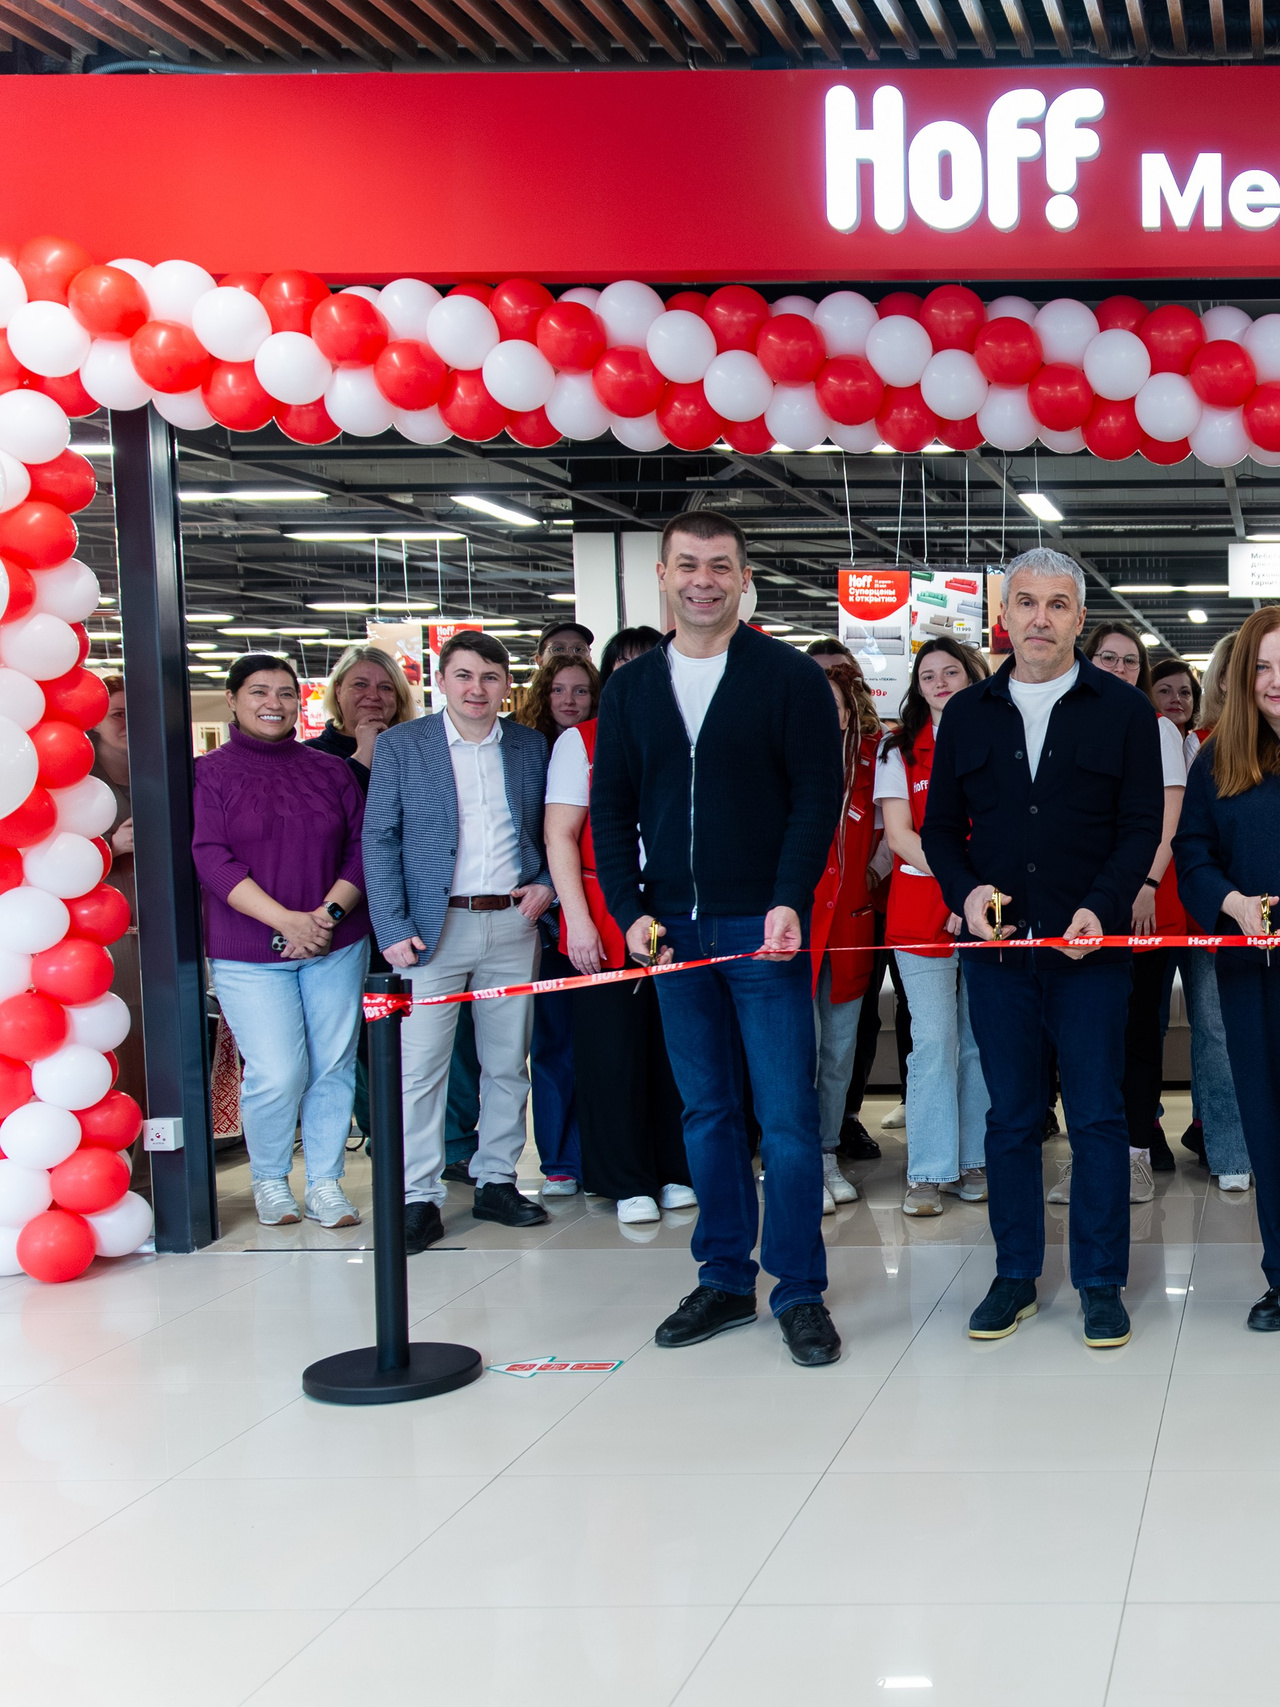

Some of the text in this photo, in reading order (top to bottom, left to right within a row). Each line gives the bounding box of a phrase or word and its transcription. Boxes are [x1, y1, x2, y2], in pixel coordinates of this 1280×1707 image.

[849, 574, 873, 588] Hoff
[849, 588, 896, 597] Суперцены
[855, 596, 898, 604] открытию
[436, 625, 455, 636] Hoff
[1128, 937, 1163, 946] Hoff
[1187, 937, 1223, 946] Hoff
